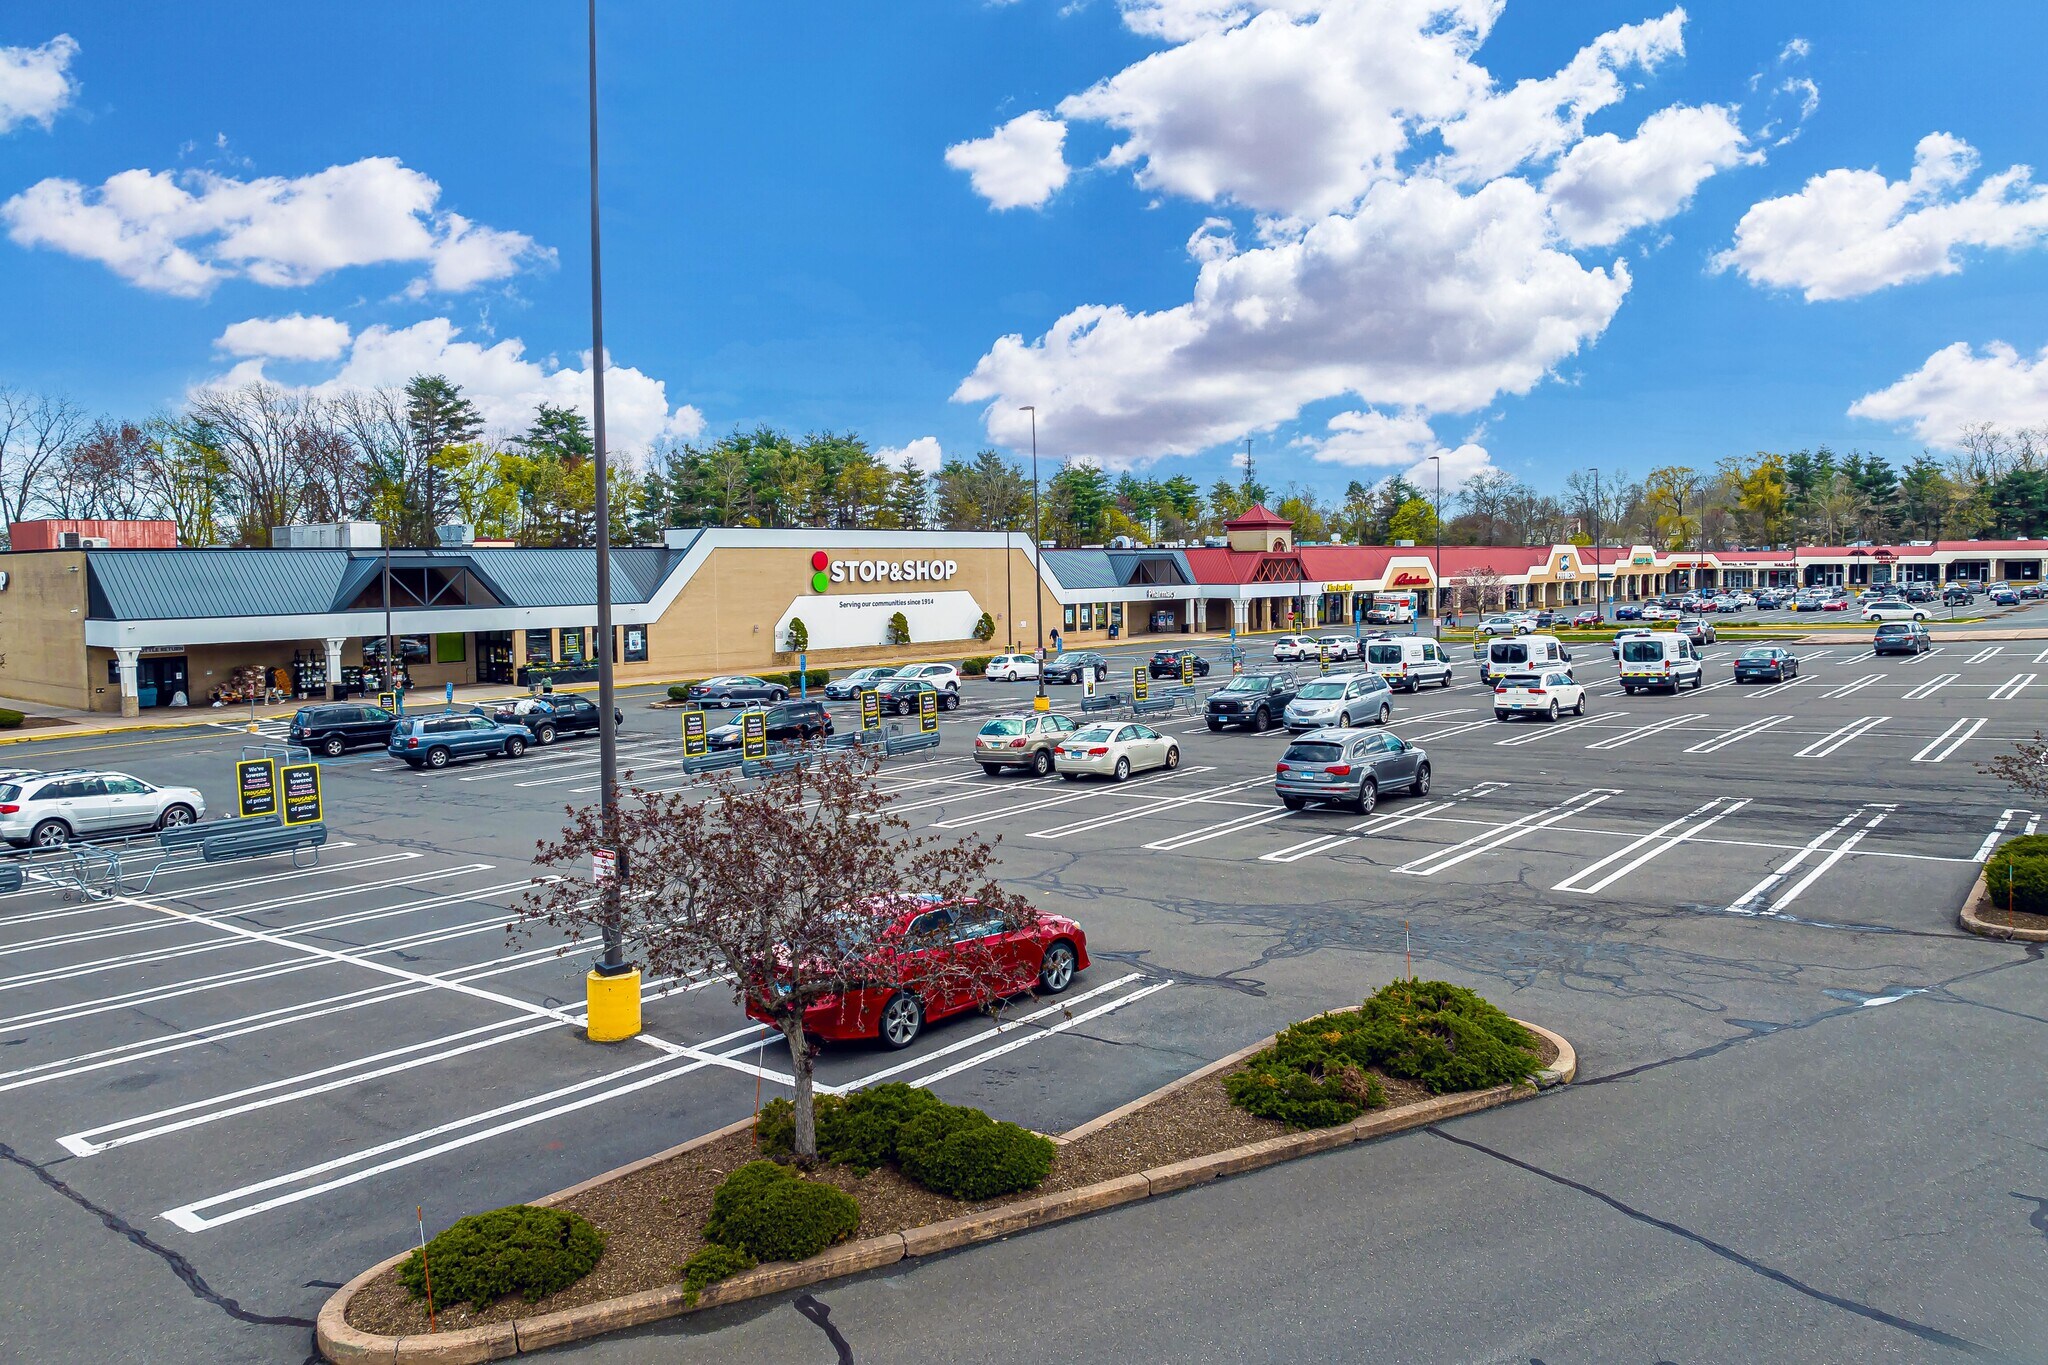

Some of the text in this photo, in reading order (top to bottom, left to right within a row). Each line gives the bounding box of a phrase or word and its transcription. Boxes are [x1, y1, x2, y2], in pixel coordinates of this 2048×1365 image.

[830, 560, 958, 582] STOP&SHOP
[1147, 589, 1176, 599] Pharmacy
[839, 601, 861, 609] Serving
